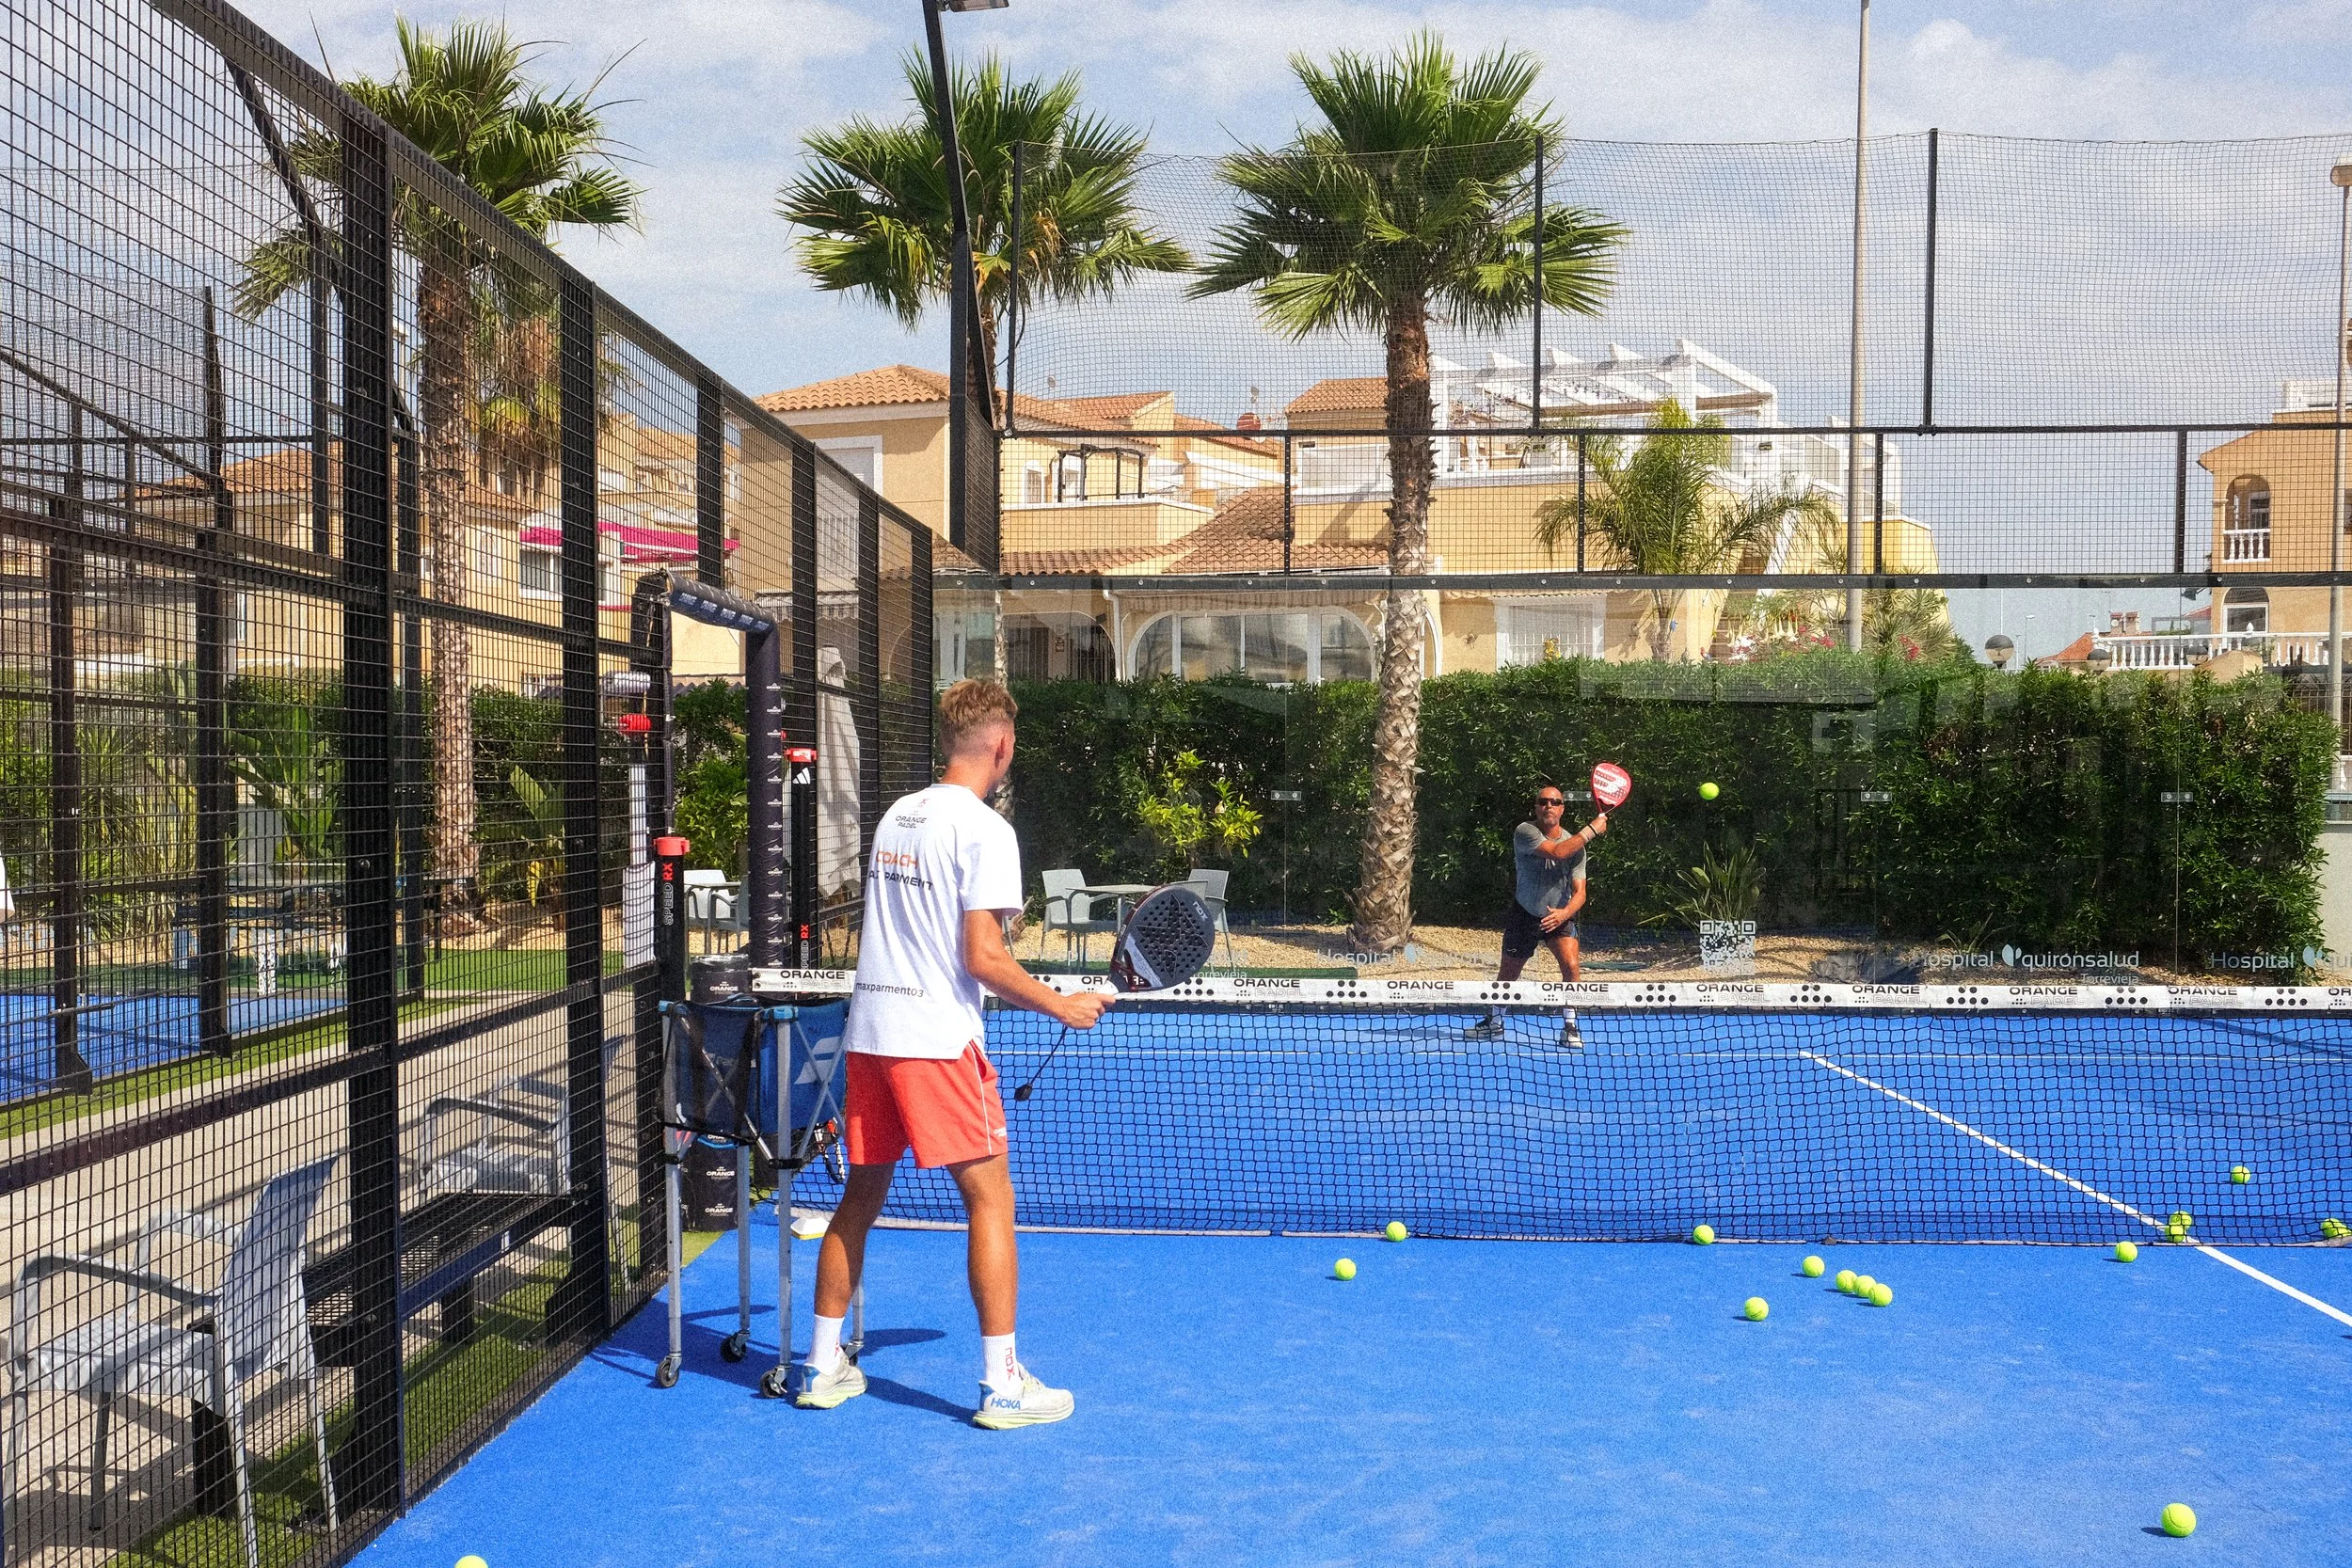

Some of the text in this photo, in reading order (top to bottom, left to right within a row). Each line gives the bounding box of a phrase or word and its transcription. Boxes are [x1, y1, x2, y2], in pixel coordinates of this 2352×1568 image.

[895, 815, 927, 824] ORANGE
[876, 850, 918, 870] COACH
[662, 863, 674, 926] SPEED RX
[1192, 900, 1209, 921] nox
[801, 924, 809, 939] RX
[2021, 950, 2139, 972] quirónsalud
[2211, 951, 2295, 973] Hospital
[780, 970, 846, 979] ORANGE
[1196, 968, 1248, 978] orrevieja
[1233, 978, 1301, 988] ORANGE
[1387, 980, 1454, 990] ORANGE
[1541, 983, 1609, 992] ORANGE
[1696, 983, 1764, 992] ORANGE
[855, 982, 924, 998] maxparment03
[1851, 985, 1920, 994] ORANGE
[2010, 987, 2078, 995] ORANGE
[2168, 986, 2238, 995] ORANGE
[1005, 1346, 1015, 1382] nox
[990, 1397, 1021, 1410] HOKA
